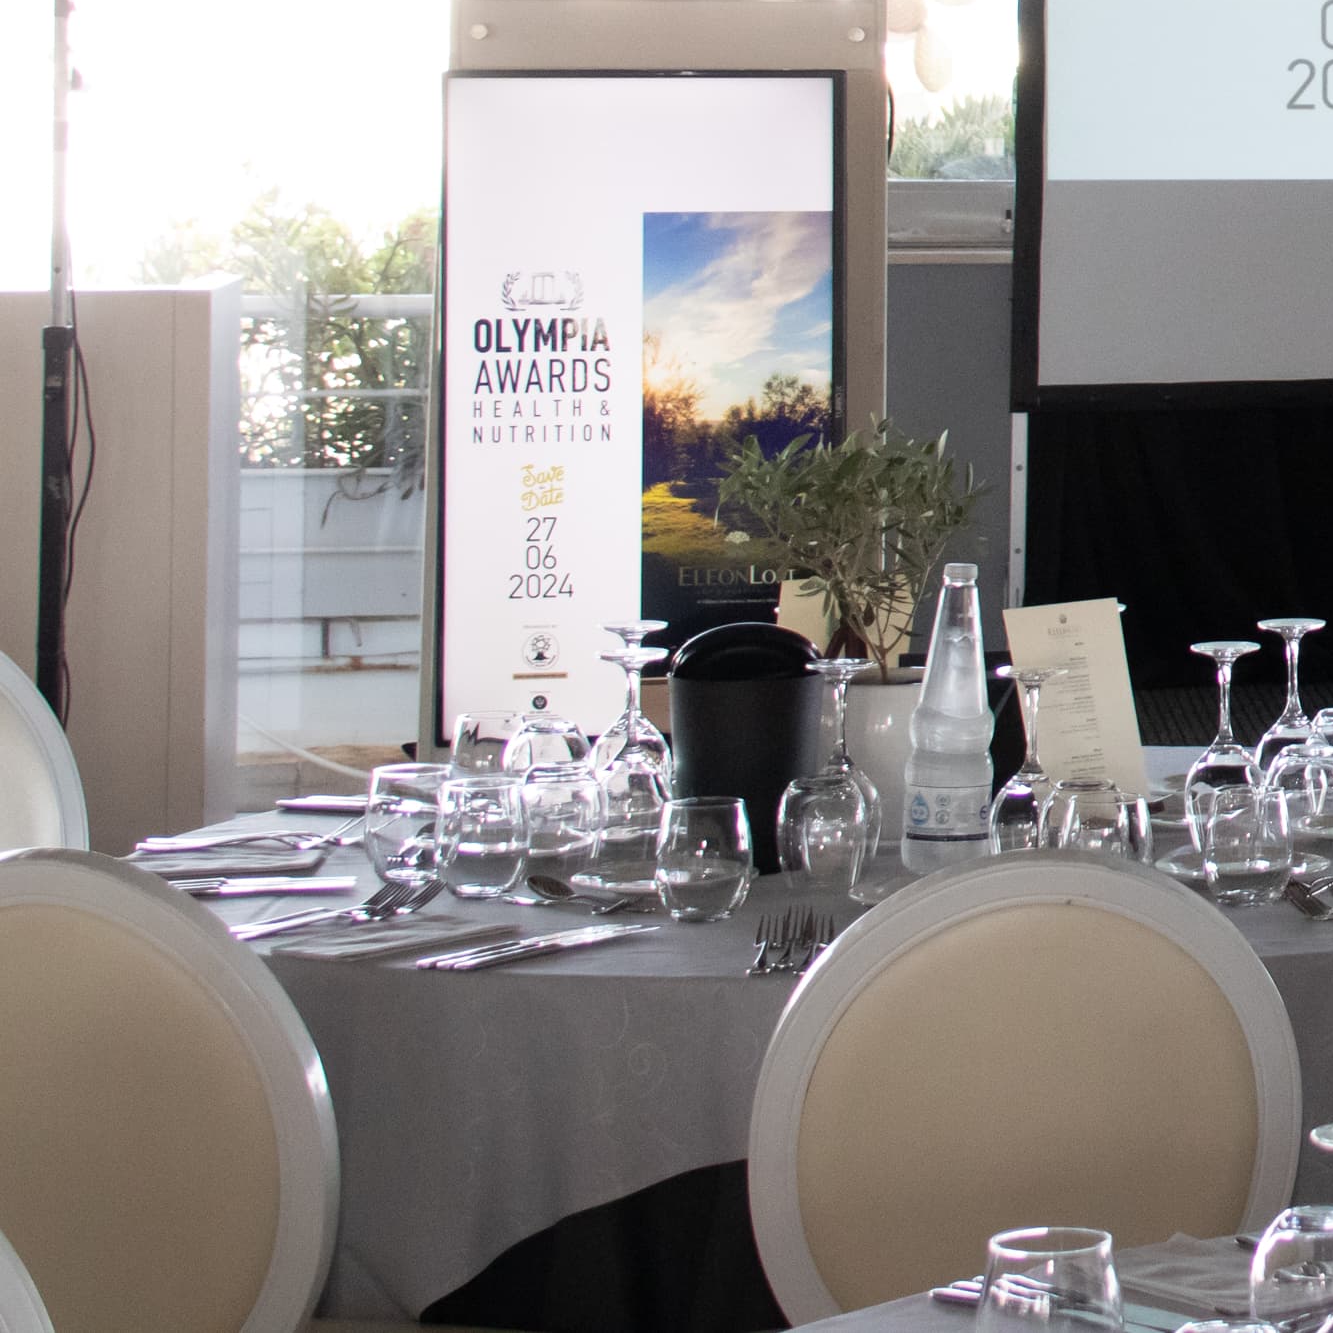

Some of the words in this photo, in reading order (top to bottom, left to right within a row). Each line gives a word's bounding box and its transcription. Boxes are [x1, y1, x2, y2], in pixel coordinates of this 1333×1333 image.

[474, 317, 611, 354] OLYMPIA
[474, 358, 611, 394] AWARDS
[473, 399, 582, 418] HEALTH
[600, 399, 610, 417] &
[473, 423, 611, 444] NUTRITION
[520, 464, 565, 488] Save
[520, 485, 565, 512] Date
[526, 516, 558, 542] 27
[526, 544, 558, 570] 06
[508, 572, 574, 600] 2024
